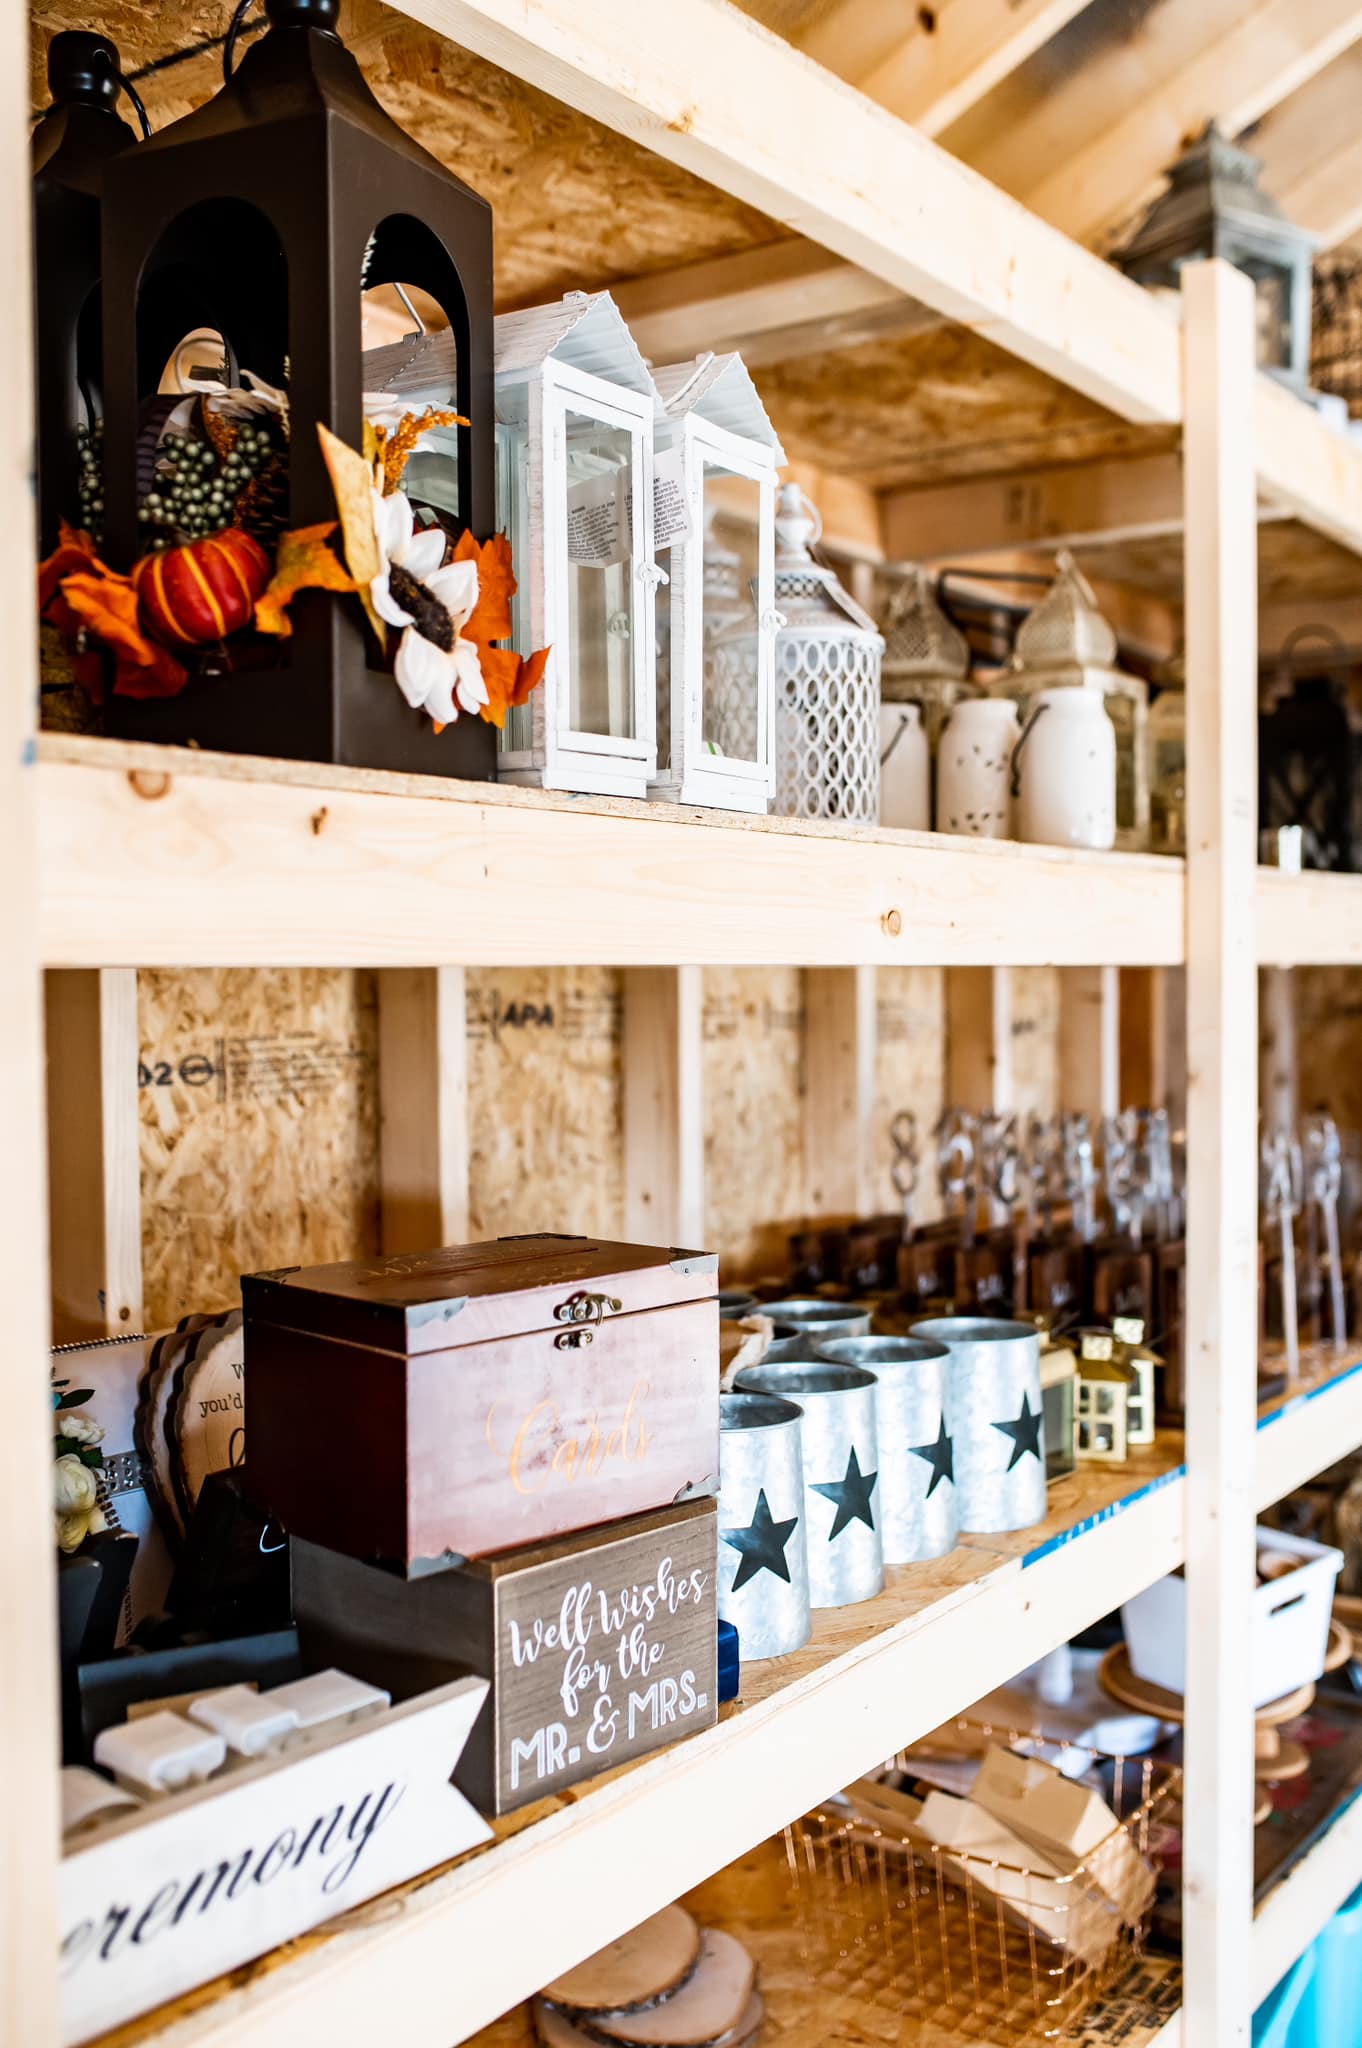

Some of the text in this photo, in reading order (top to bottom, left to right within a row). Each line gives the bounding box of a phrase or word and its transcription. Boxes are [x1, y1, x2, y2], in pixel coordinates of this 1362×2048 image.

[503, 1001, 555, 1029] APA
[199, 1393, 243, 1418] you'd
[485, 1376, 657, 1494] Cards
[508, 1556, 708, 1668] Well Wishes
[560, 1622, 665, 1718] for the
[510, 1669, 708, 1790] MR. & MRS.
[60, 1782, 402, 1975] eremony
